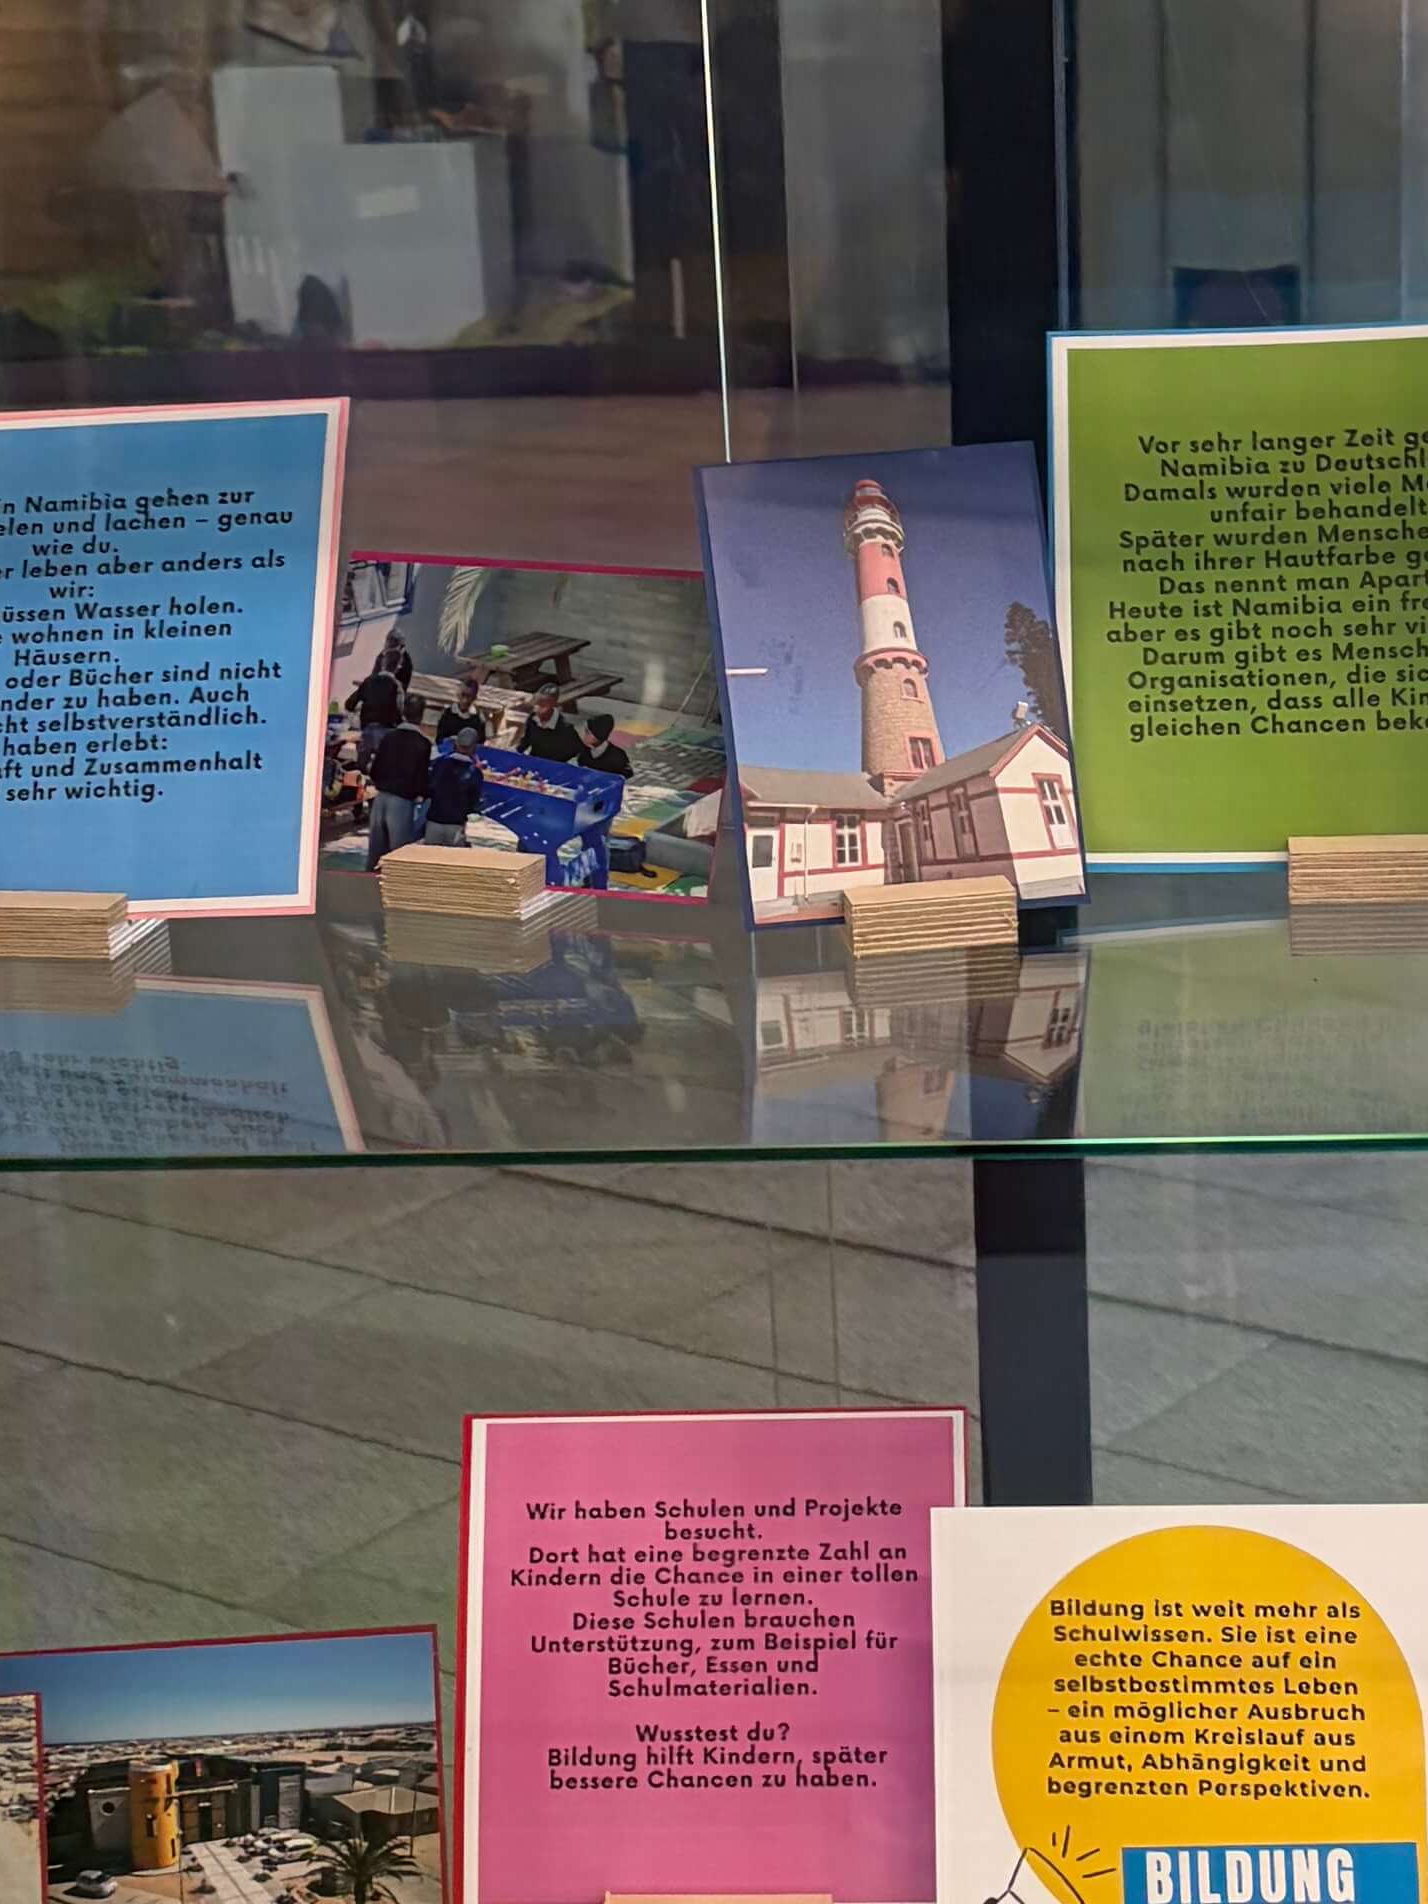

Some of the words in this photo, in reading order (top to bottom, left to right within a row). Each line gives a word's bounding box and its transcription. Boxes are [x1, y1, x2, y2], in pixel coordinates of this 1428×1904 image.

[1138, 435, 1182, 455] Vor
[1188, 431, 1244, 454] sehr
[1252, 430, 1336, 458] langer
[1344, 427, 1396, 448] Zeit
[24, 491, 127, 514] Namibia
[134, 486, 209, 518] gehen
[217, 491, 255, 505] zur
[21, 558, 88, 579] leben
[96, 554, 154, 576] aber
[160, 551, 243, 573] anders
[251, 548, 285, 569] als
[1122, 550, 1186, 573] nach
[1194, 549, 1256, 572] ihrer
[1264, 543, 1396, 569] Hautfarbe
[75, 601, 162, 620] Wasser
[169, 594, 244, 617] holen.
[1106, 621, 1166, 644] aber
[1174, 627, 1201, 642] es
[1209, 618, 1262, 649] gibt
[1271, 616, 1333, 639] noch
[1343, 614, 1397, 637] sehr
[14, 648, 120, 667] Häusern.
[1129, 714, 1241, 744] gleichen
[1250, 712, 1366, 735] Chancen
[5, 778, 57, 802] sehr
[64, 777, 163, 804] wichtig.
[526, 1502, 567, 1521] Wir
[574, 1499, 646, 1520] haben
[654, 1497, 745, 1519] Schulen
[753, 1496, 796, 1518] und
[804, 1495, 902, 1523] Projekte
[510, 1565, 601, 1587] Kindern
[609, 1564, 646, 1586] die
[654, 1563, 744, 1585] Chance
[753, 1566, 773, 1584] in
[782, 1565, 843, 1584] einer
[850, 1561, 922, 1584] tollen
[573, 1611, 636, 1631] Diese
[643, 1608, 735, 1630] Schulen
[744, 1607, 855, 1629] brauchen
[1049, 1598, 1144, 1621] Bildung
[1154, 1598, 1183, 1618] ist
[1191, 1599, 1245, 1618] weit
[1254, 1601, 1318, 1619] mehr
[1326, 1601, 1361, 1619] als
[1221, 1624, 1258, 1644] Sie
[1266, 1625, 1296, 1644] ist
[1305, 1625, 1358, 1645] eine
[1074, 1649, 1143, 1668] echte
[1151, 1650, 1243, 1669] Chance
[1251, 1651, 1291, 1669] auf
[1299, 1650, 1336, 1669] ein
[1054, 1674, 1275, 1695] selbstbestimmtes
[1284, 1677, 1359, 1696] Leben
[635, 1724, 739, 1743] Wusstest
[746, 1720, 791, 1742] du?
[1048, 1752, 1133, 1777] Armut,
[1141, 1751, 1311, 1776] Abhängigkeit
[1319, 1754, 1366, 1772] und
[1146, 1848, 1356, 1904] BILDUNG
